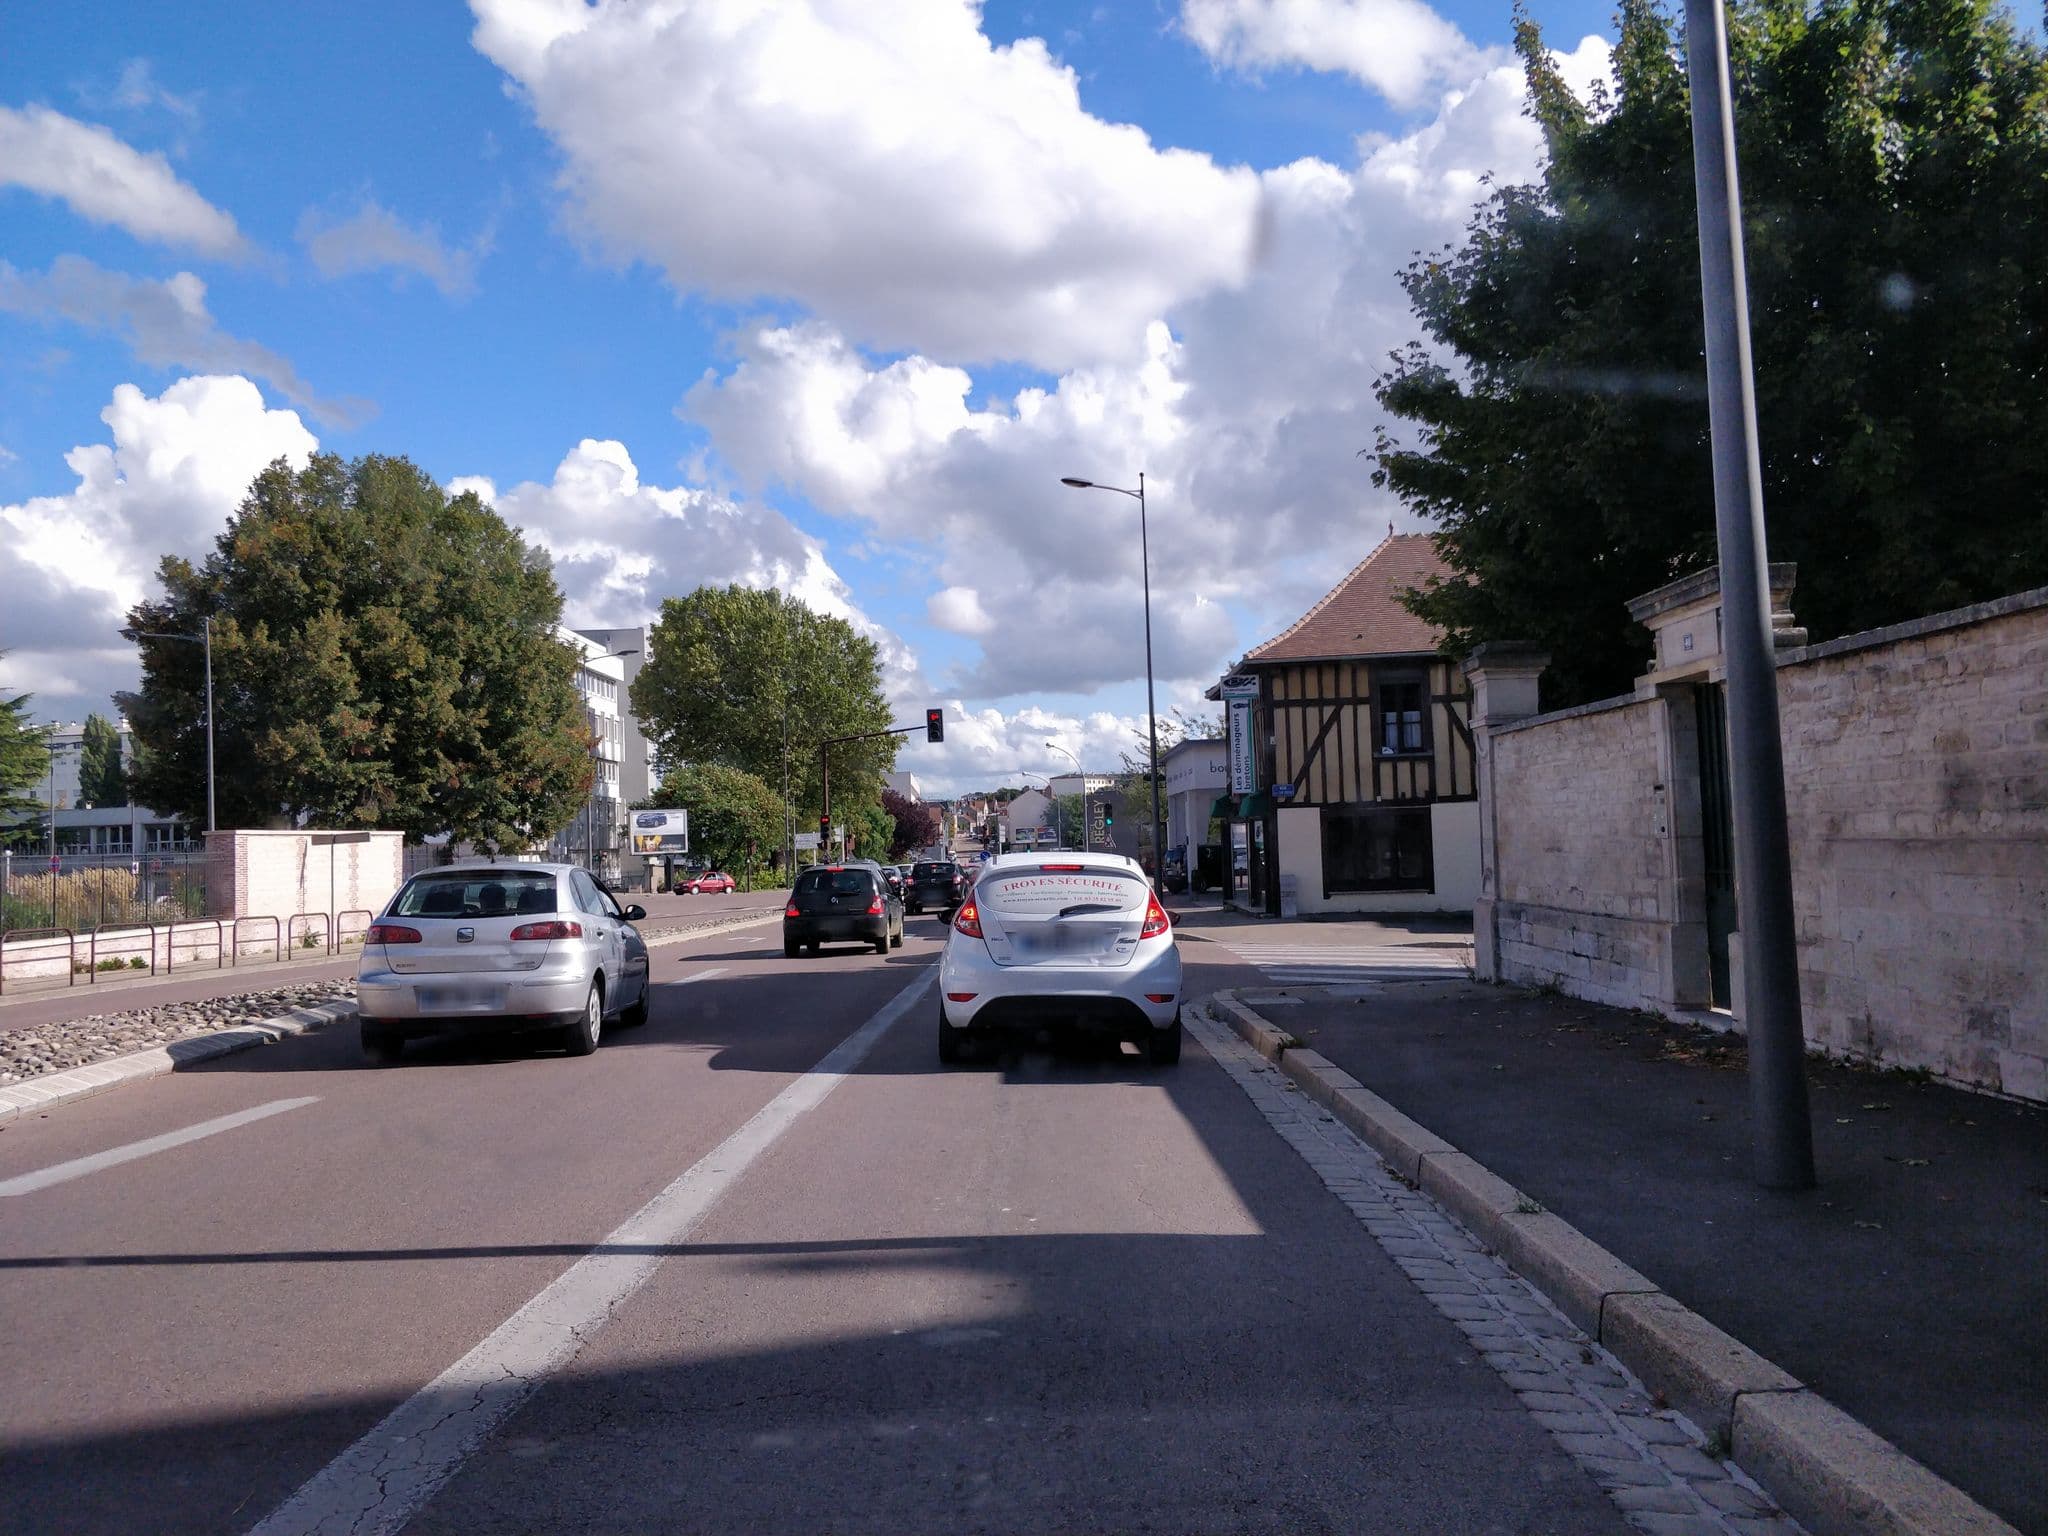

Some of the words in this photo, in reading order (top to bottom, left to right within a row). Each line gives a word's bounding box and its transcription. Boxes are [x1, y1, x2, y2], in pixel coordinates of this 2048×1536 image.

[1233, 713, 1242, 774] déménageurs
[1002, 879, 1054, 892] TROYES
[1058, 877, 1122, 891] SÉCURITÉ
